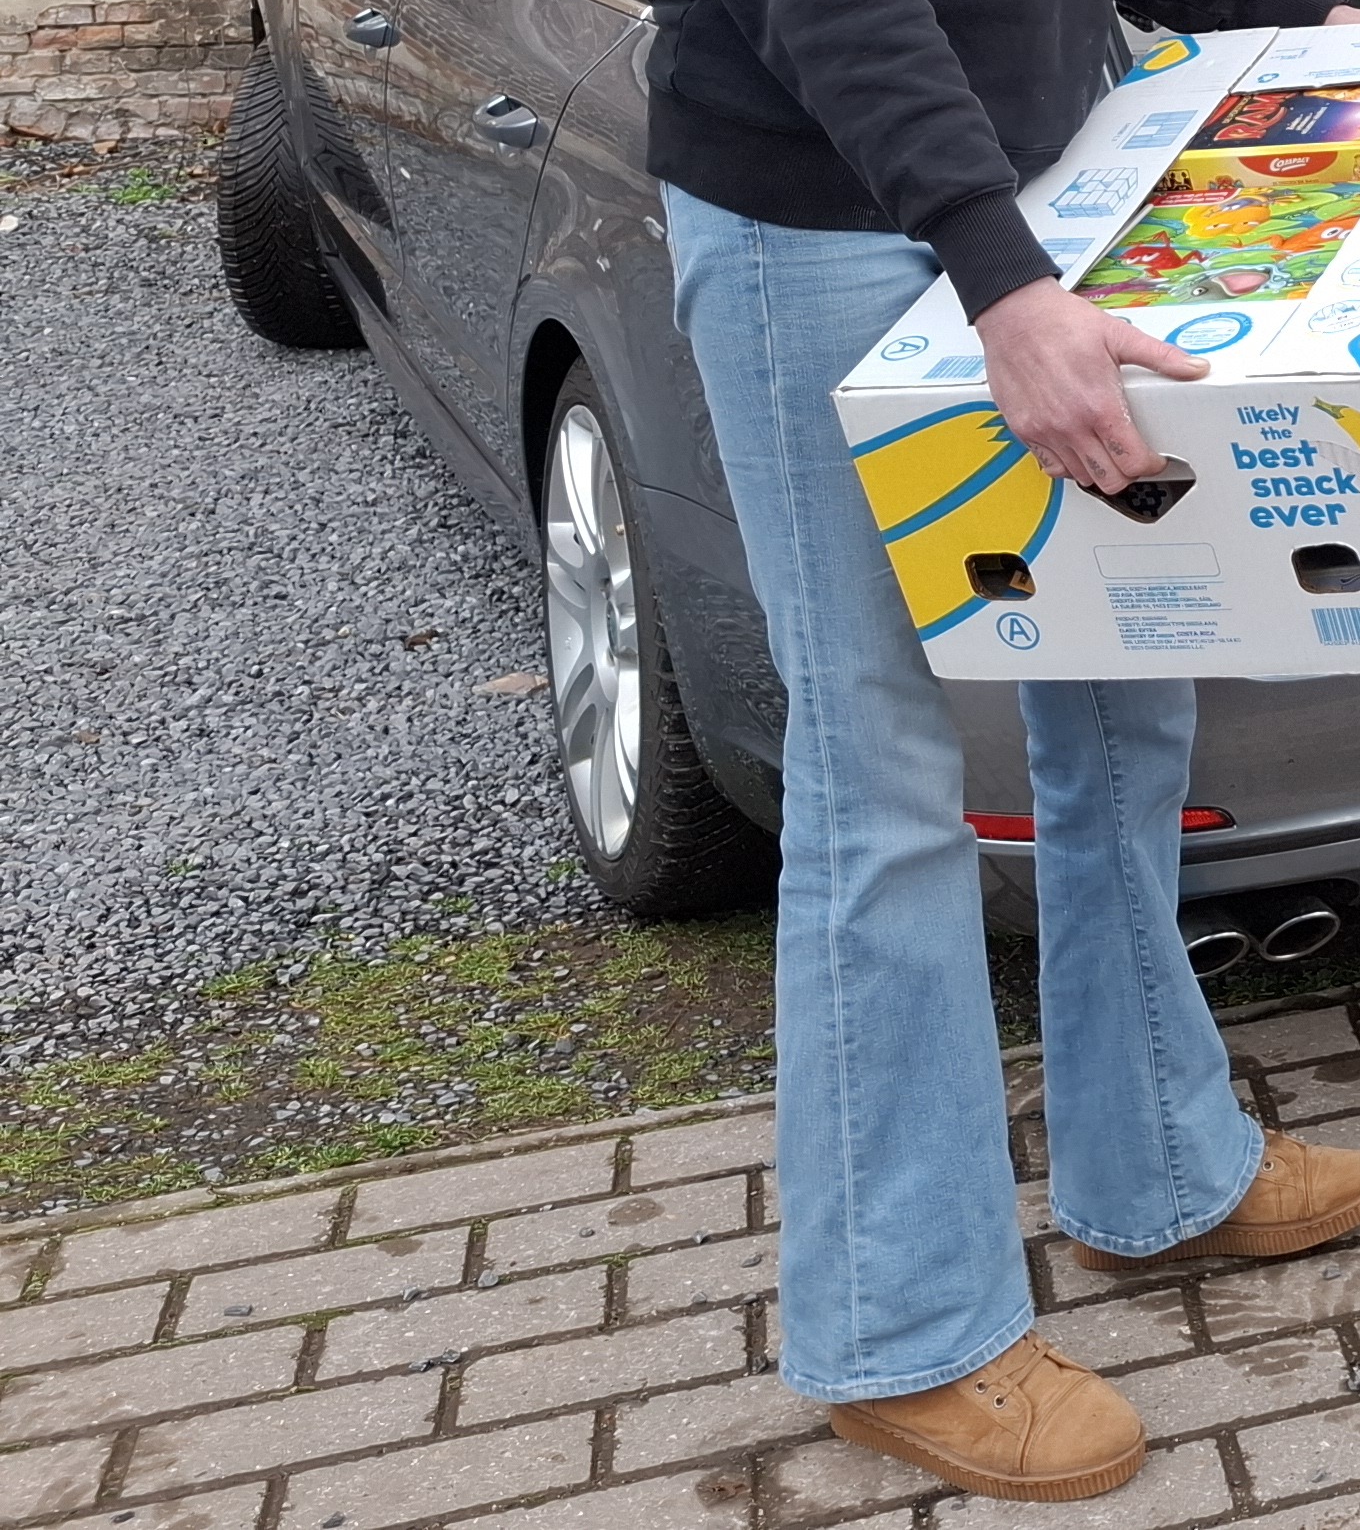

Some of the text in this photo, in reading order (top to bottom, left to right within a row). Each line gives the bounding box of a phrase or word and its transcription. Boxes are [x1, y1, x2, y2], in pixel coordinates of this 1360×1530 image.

[1236, 403, 1300, 425] likely
[1260, 427, 1293, 441] the
[1230, 439, 1318, 470] best
[1250, 467, 1360, 498] snack
[1249, 502, 1347, 529] ever
[1009, 617, 1033, 642] A
